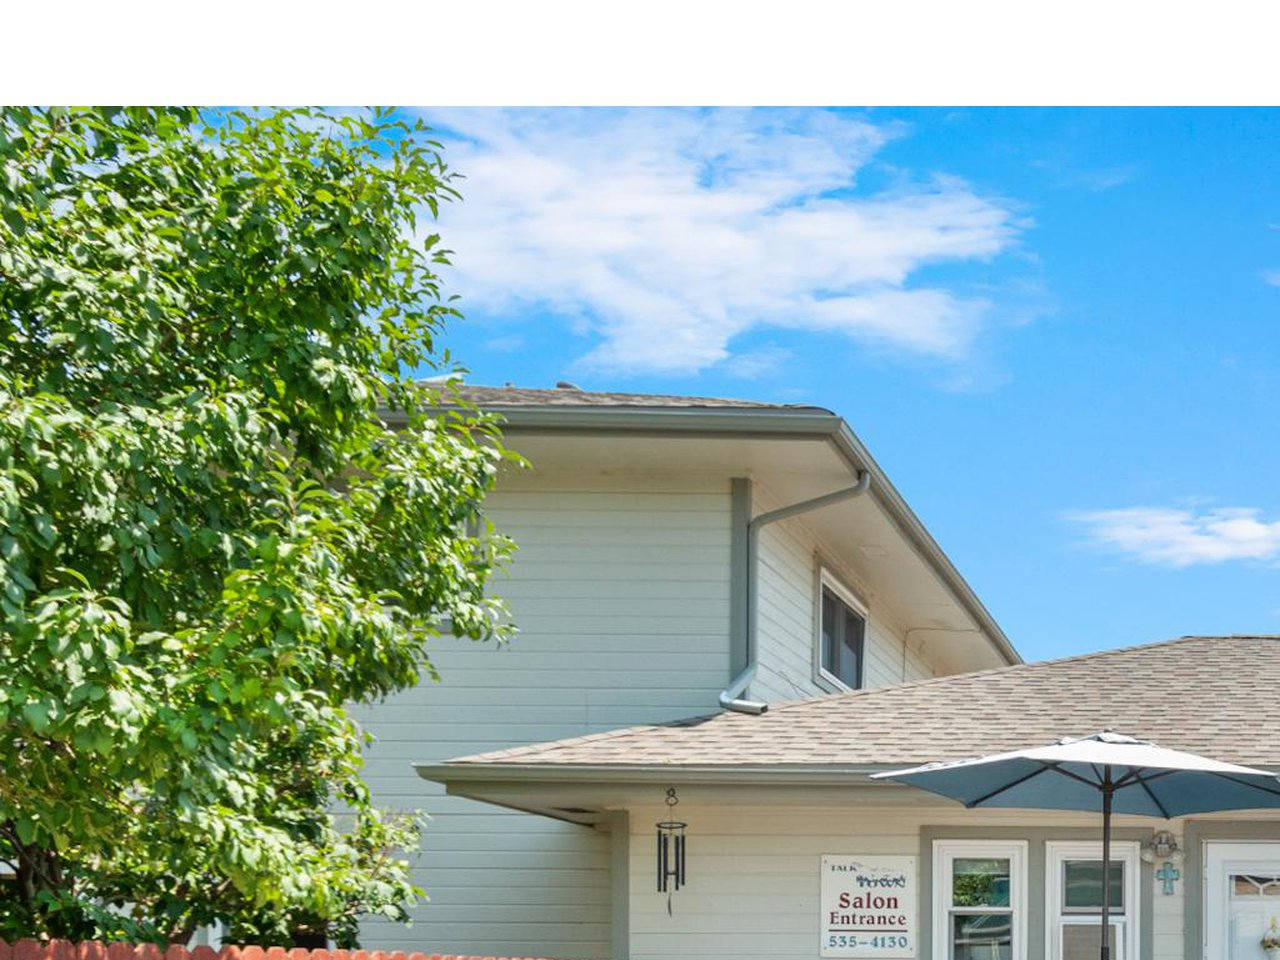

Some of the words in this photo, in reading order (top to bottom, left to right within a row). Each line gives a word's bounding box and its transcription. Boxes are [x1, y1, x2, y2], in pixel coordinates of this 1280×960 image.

[838, 892, 899, 910] Salon
[829, 912, 907, 926] Entrance
[828, 936, 908, 948] 535-4130
